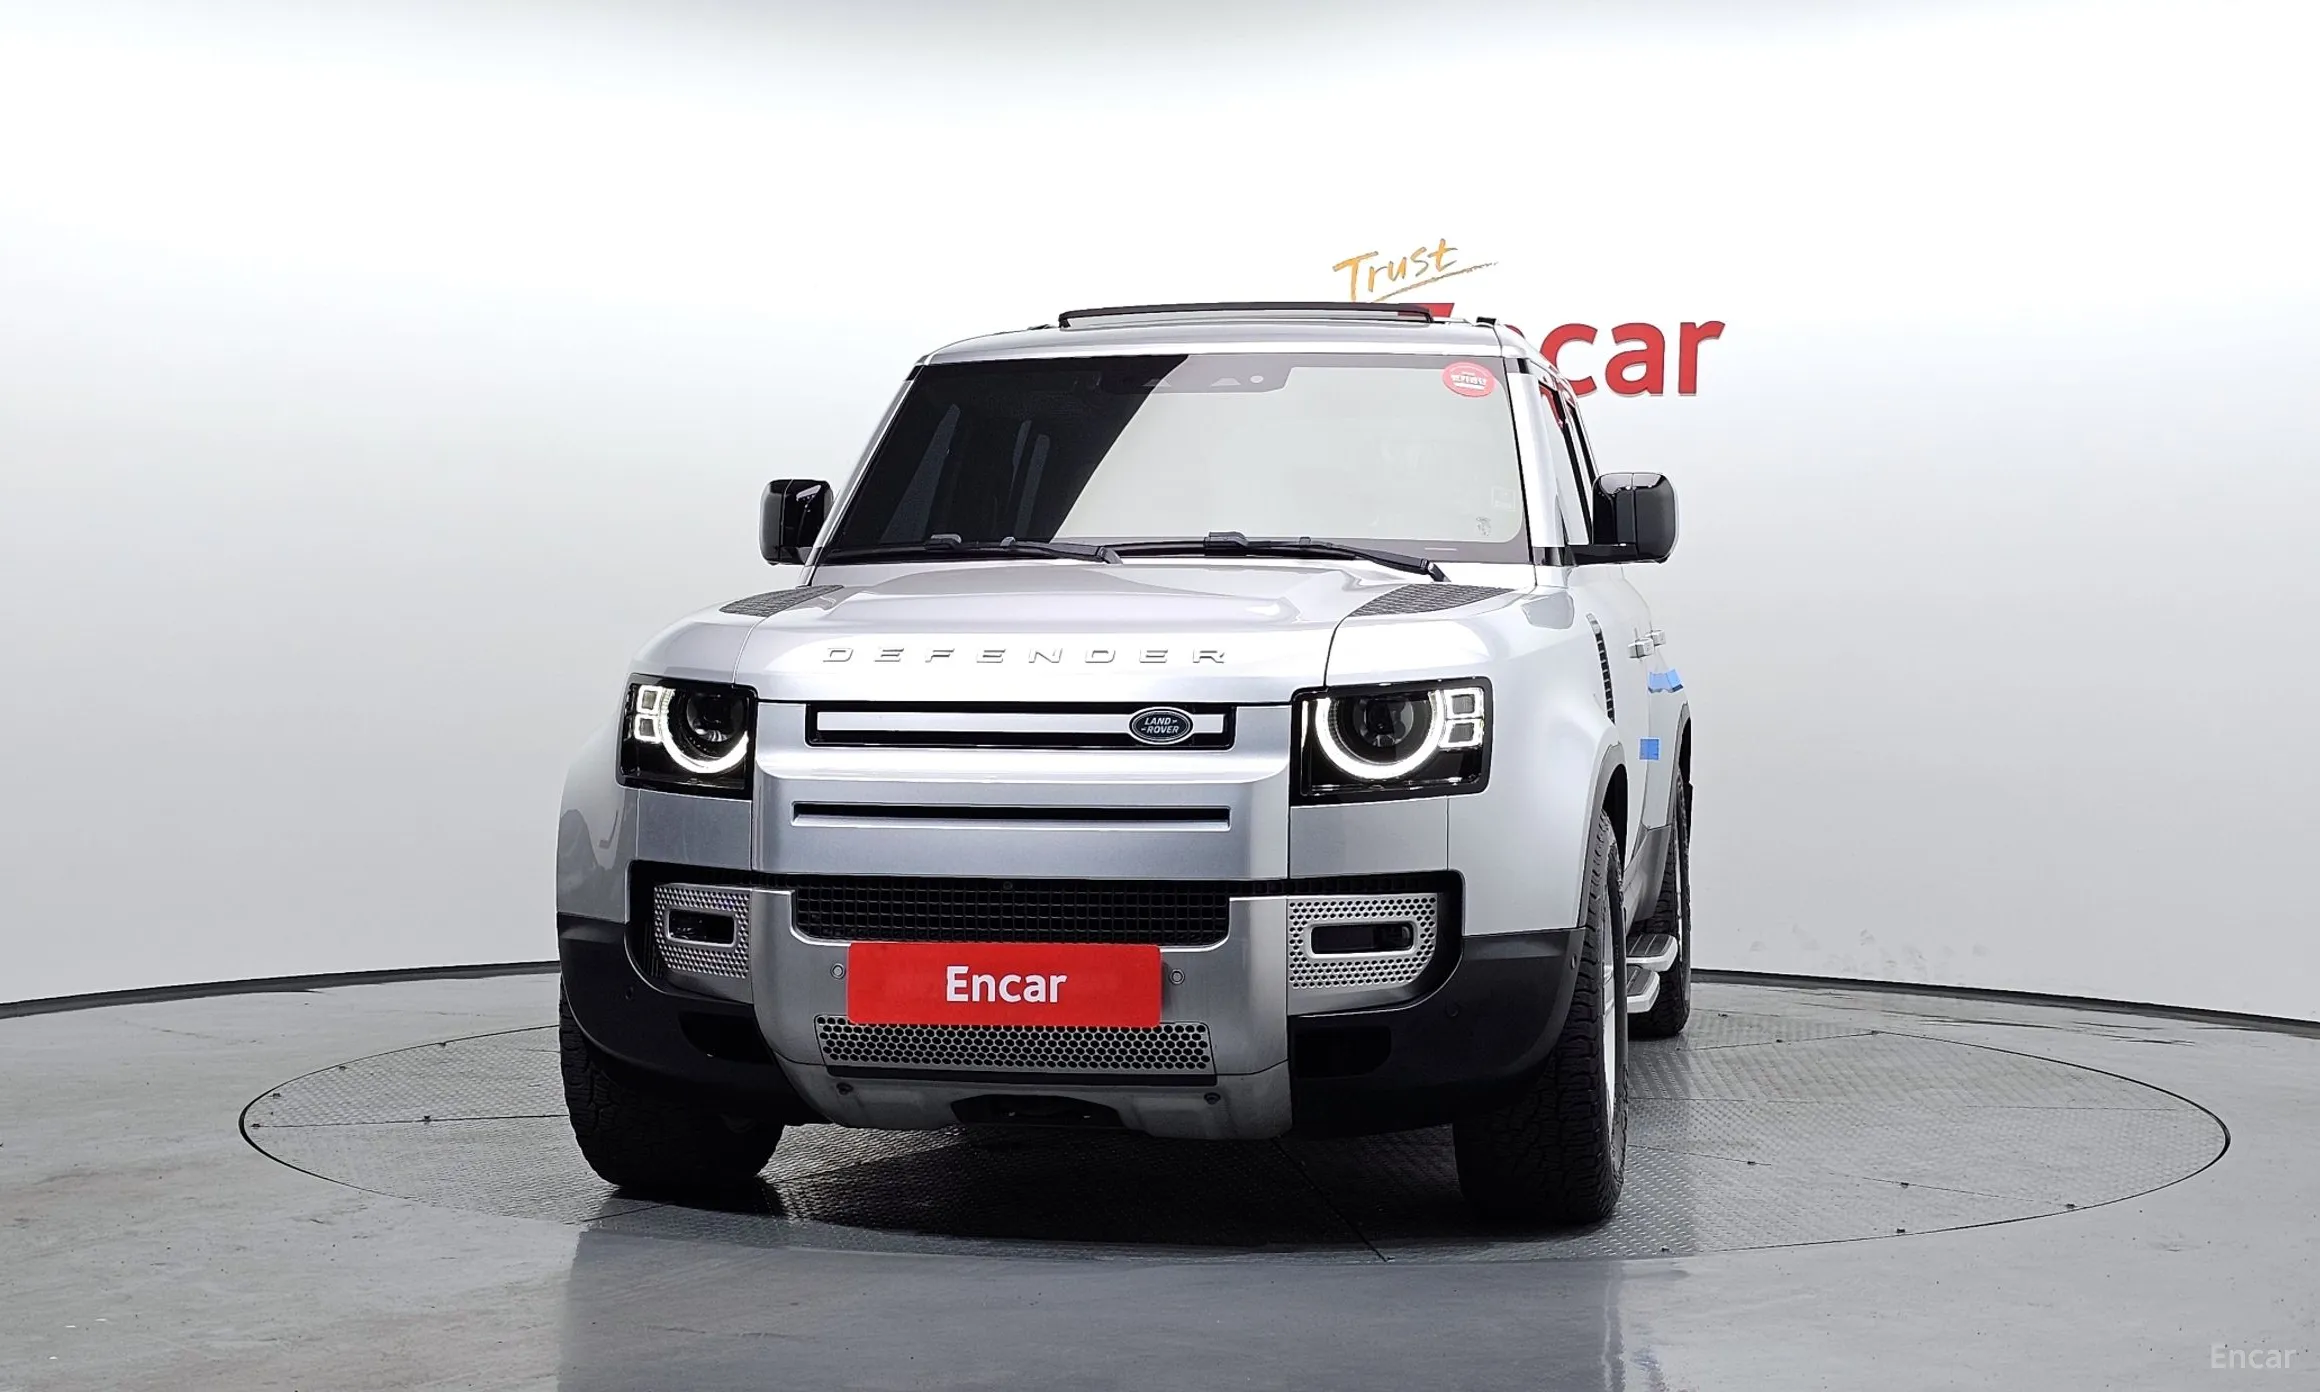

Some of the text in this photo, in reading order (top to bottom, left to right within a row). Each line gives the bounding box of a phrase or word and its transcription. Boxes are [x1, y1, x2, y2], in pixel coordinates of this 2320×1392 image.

[1332, 237, 1459, 302] Trust
[822, 647, 1227, 664] DEFENDER
[1144, 717, 1171, 725] LAND
[1146, 726, 1179, 734] ROVER
[946, 965, 1067, 1003] Encar
